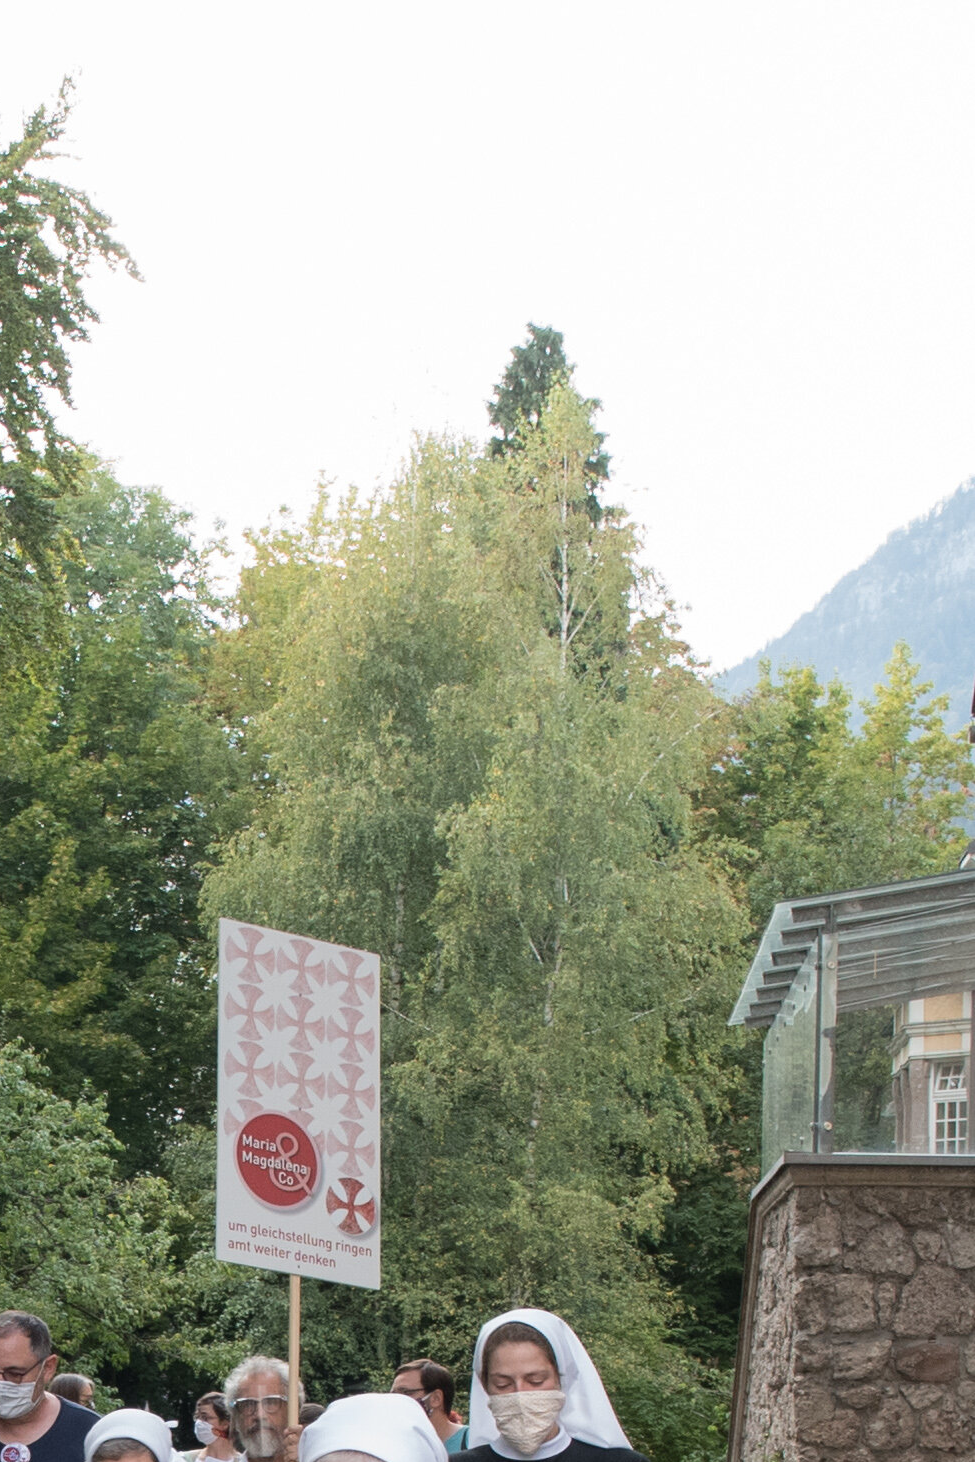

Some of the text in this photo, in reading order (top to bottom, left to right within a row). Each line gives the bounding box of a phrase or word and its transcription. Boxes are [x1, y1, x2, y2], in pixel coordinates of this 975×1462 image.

[241, 1133, 277, 1152] Maria
[241, 1150, 308, 1175] Magdalena
[278, 1171, 294, 1186] Co
[228, 1220, 372, 1258] um gleichstellung ringen
[227, 1238, 336, 1268] amt weiter denken
